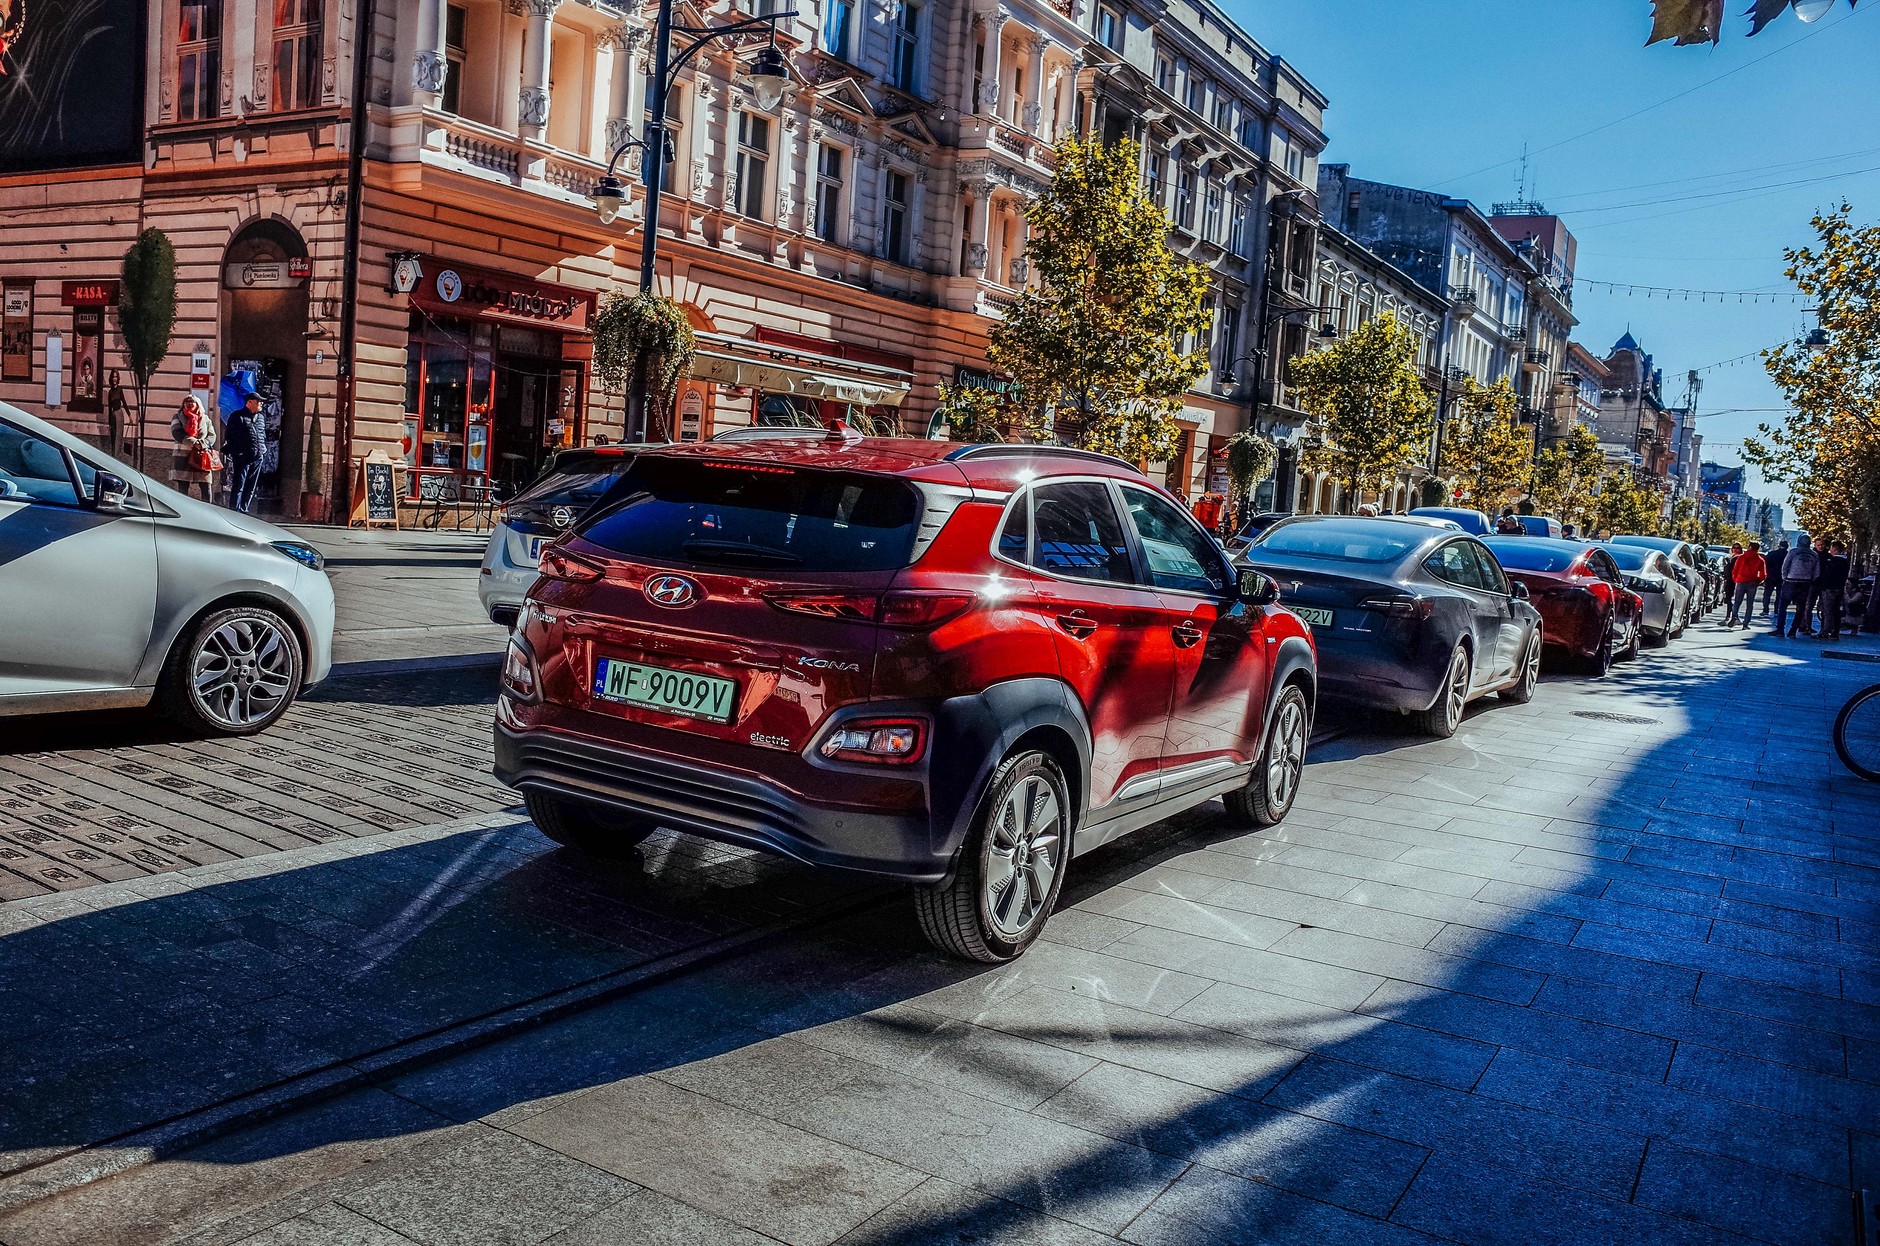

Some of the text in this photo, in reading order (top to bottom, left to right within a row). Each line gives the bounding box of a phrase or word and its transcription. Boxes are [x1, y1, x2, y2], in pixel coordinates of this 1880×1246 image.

[508, 291, 554, 316] MIÓD
[959, 370, 1007, 393] Carrefour
[798, 656, 860, 672] KONA
[595, 679, 604, 689] PL
[610, 664, 728, 714] WF 9009V
[750, 731, 790, 747] electric
